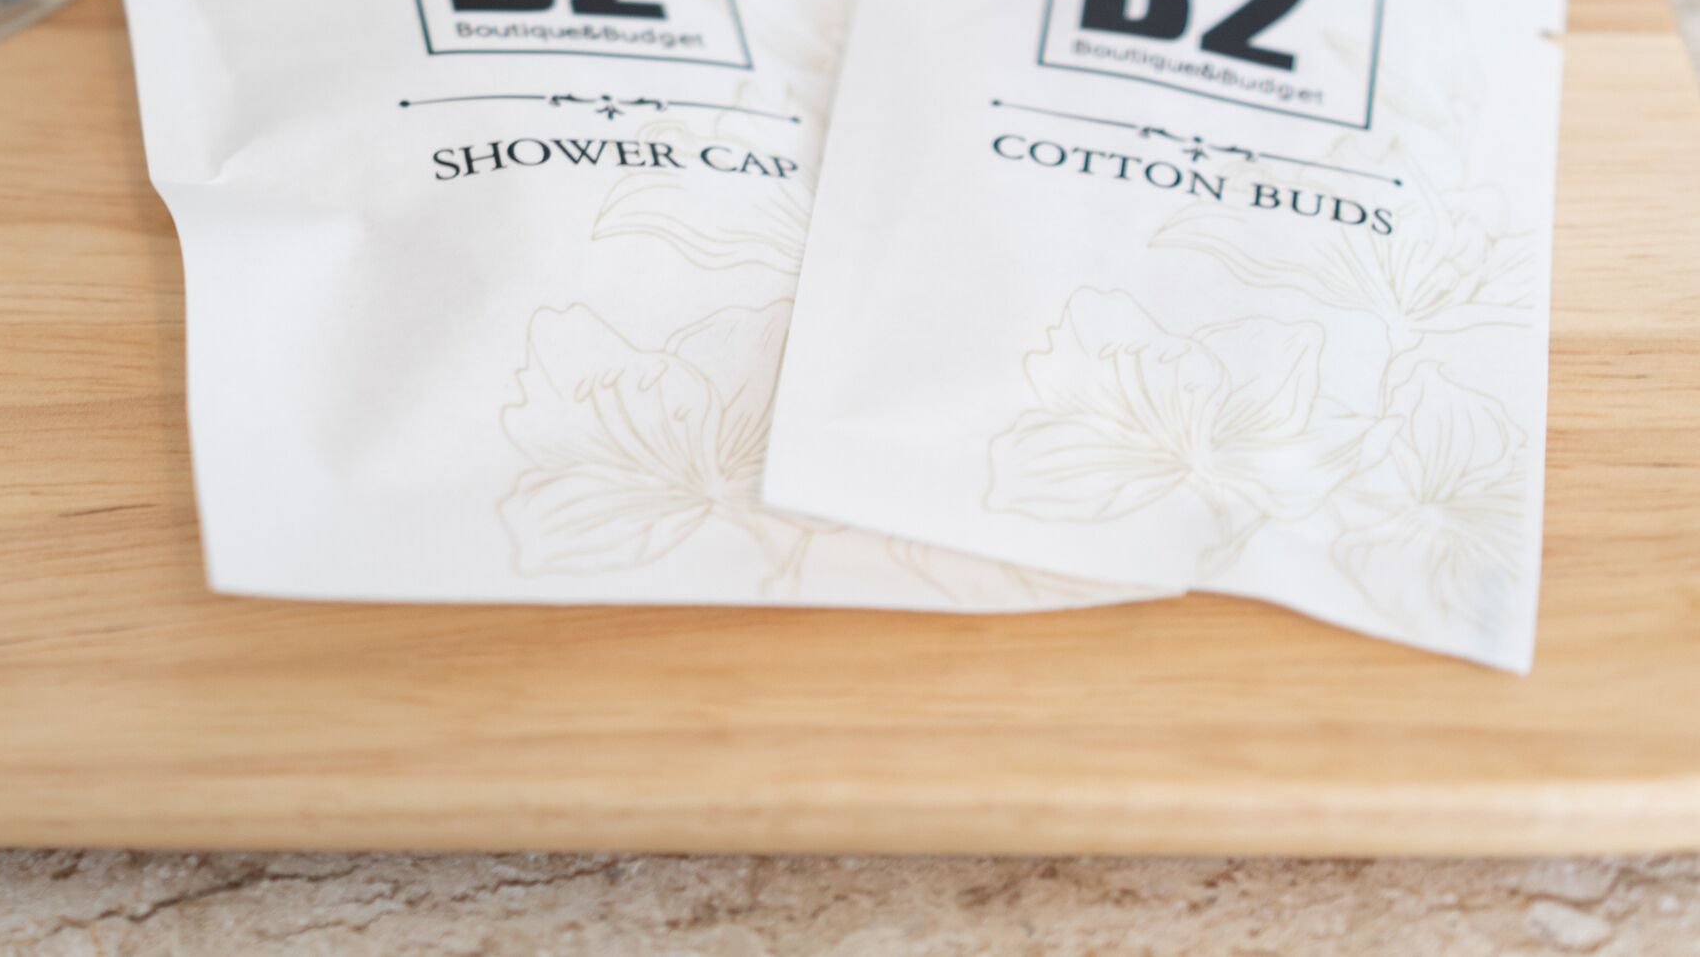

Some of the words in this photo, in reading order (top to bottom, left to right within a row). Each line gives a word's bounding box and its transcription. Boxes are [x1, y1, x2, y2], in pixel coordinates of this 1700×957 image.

[456, 21, 704, 49] Boutique&Budget
[1071, 37, 1324, 105] Boutique&Budget
[432, 138, 686, 181] SHOWER
[700, 145, 799, 179] CAP
[992, 134, 1227, 201] COTTON
[1250, 182, 1393, 236] BUDS
